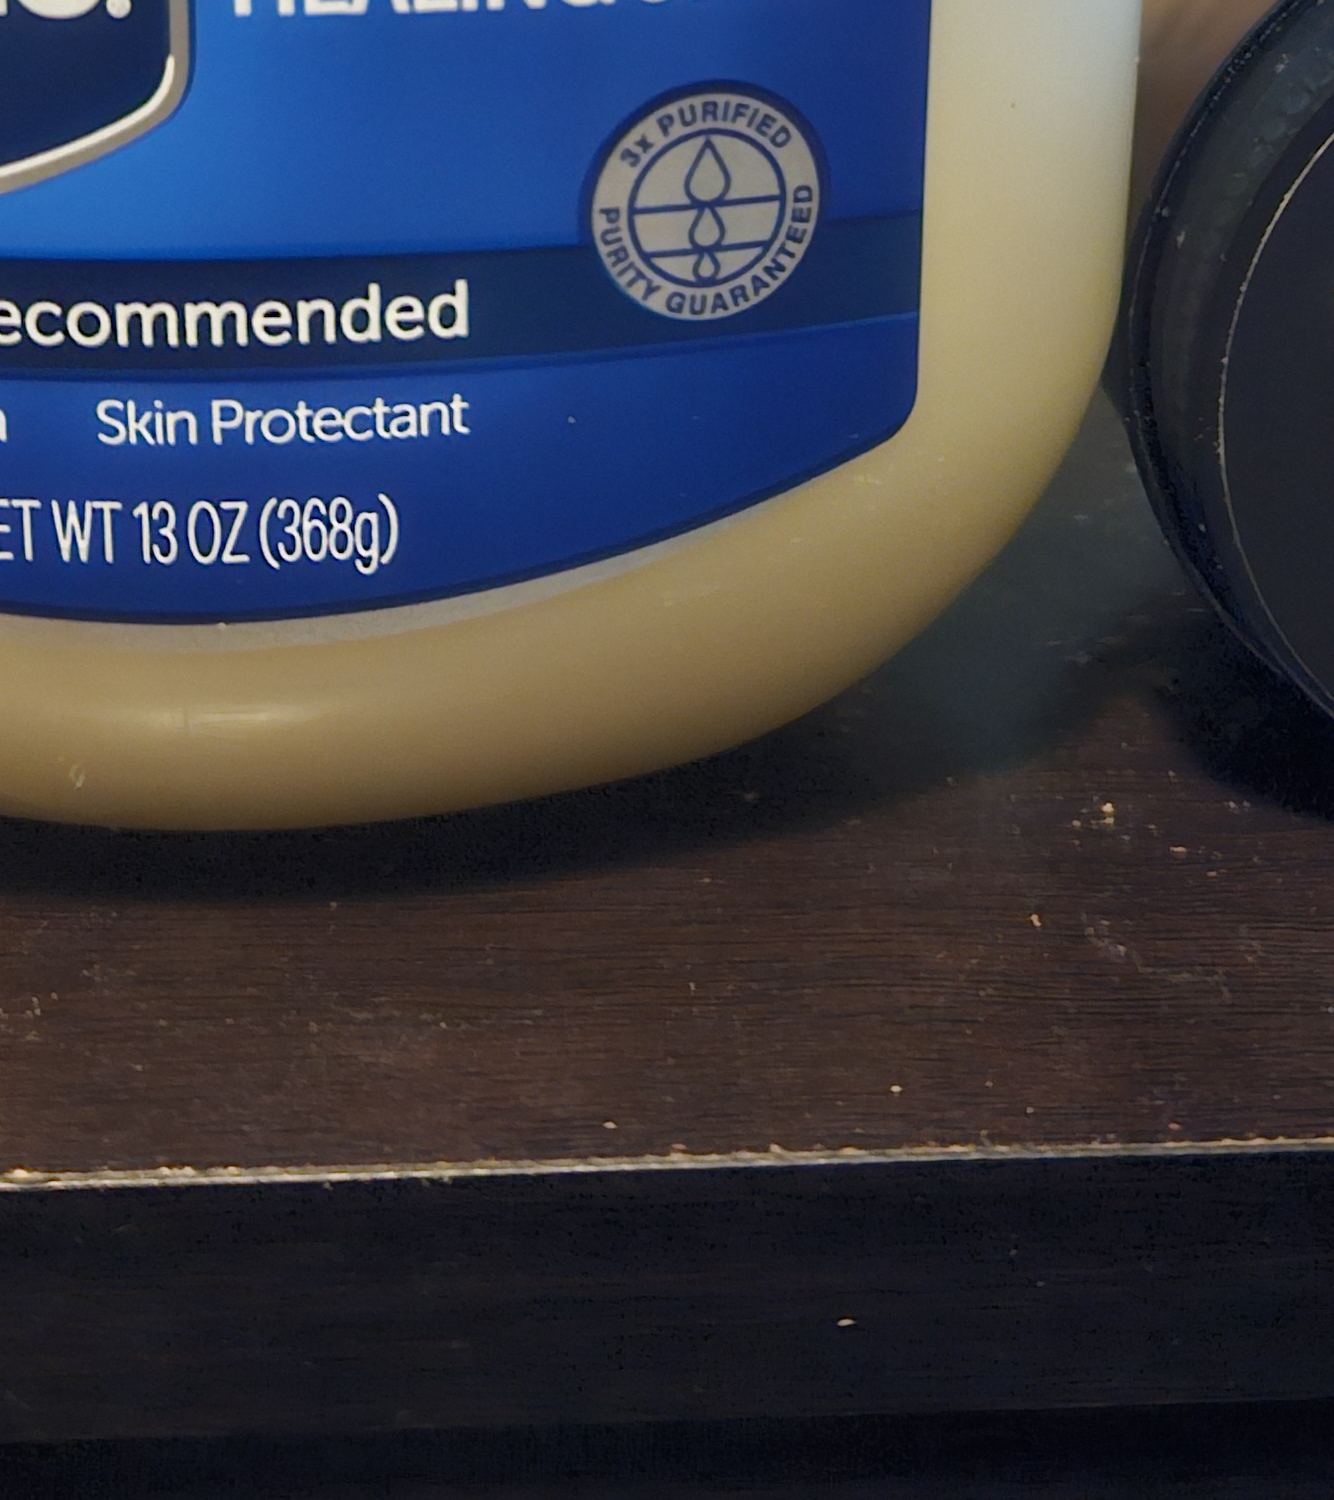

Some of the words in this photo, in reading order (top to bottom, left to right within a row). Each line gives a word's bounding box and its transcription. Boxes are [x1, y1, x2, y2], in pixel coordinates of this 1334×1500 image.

[656, 100, 792, 150] PURIFIED
[598, 205, 661, 302] PURITY
[666, 184, 814, 317] GUARANTEED
[96, 398, 197, 445] Skin
[211, 393, 471, 444] Protectant
[51, 498, 123, 564] WT
[132, 500, 178, 565] 13
[186, 501, 250, 565] OZ
[259, 493, 399, 575] (368g)
